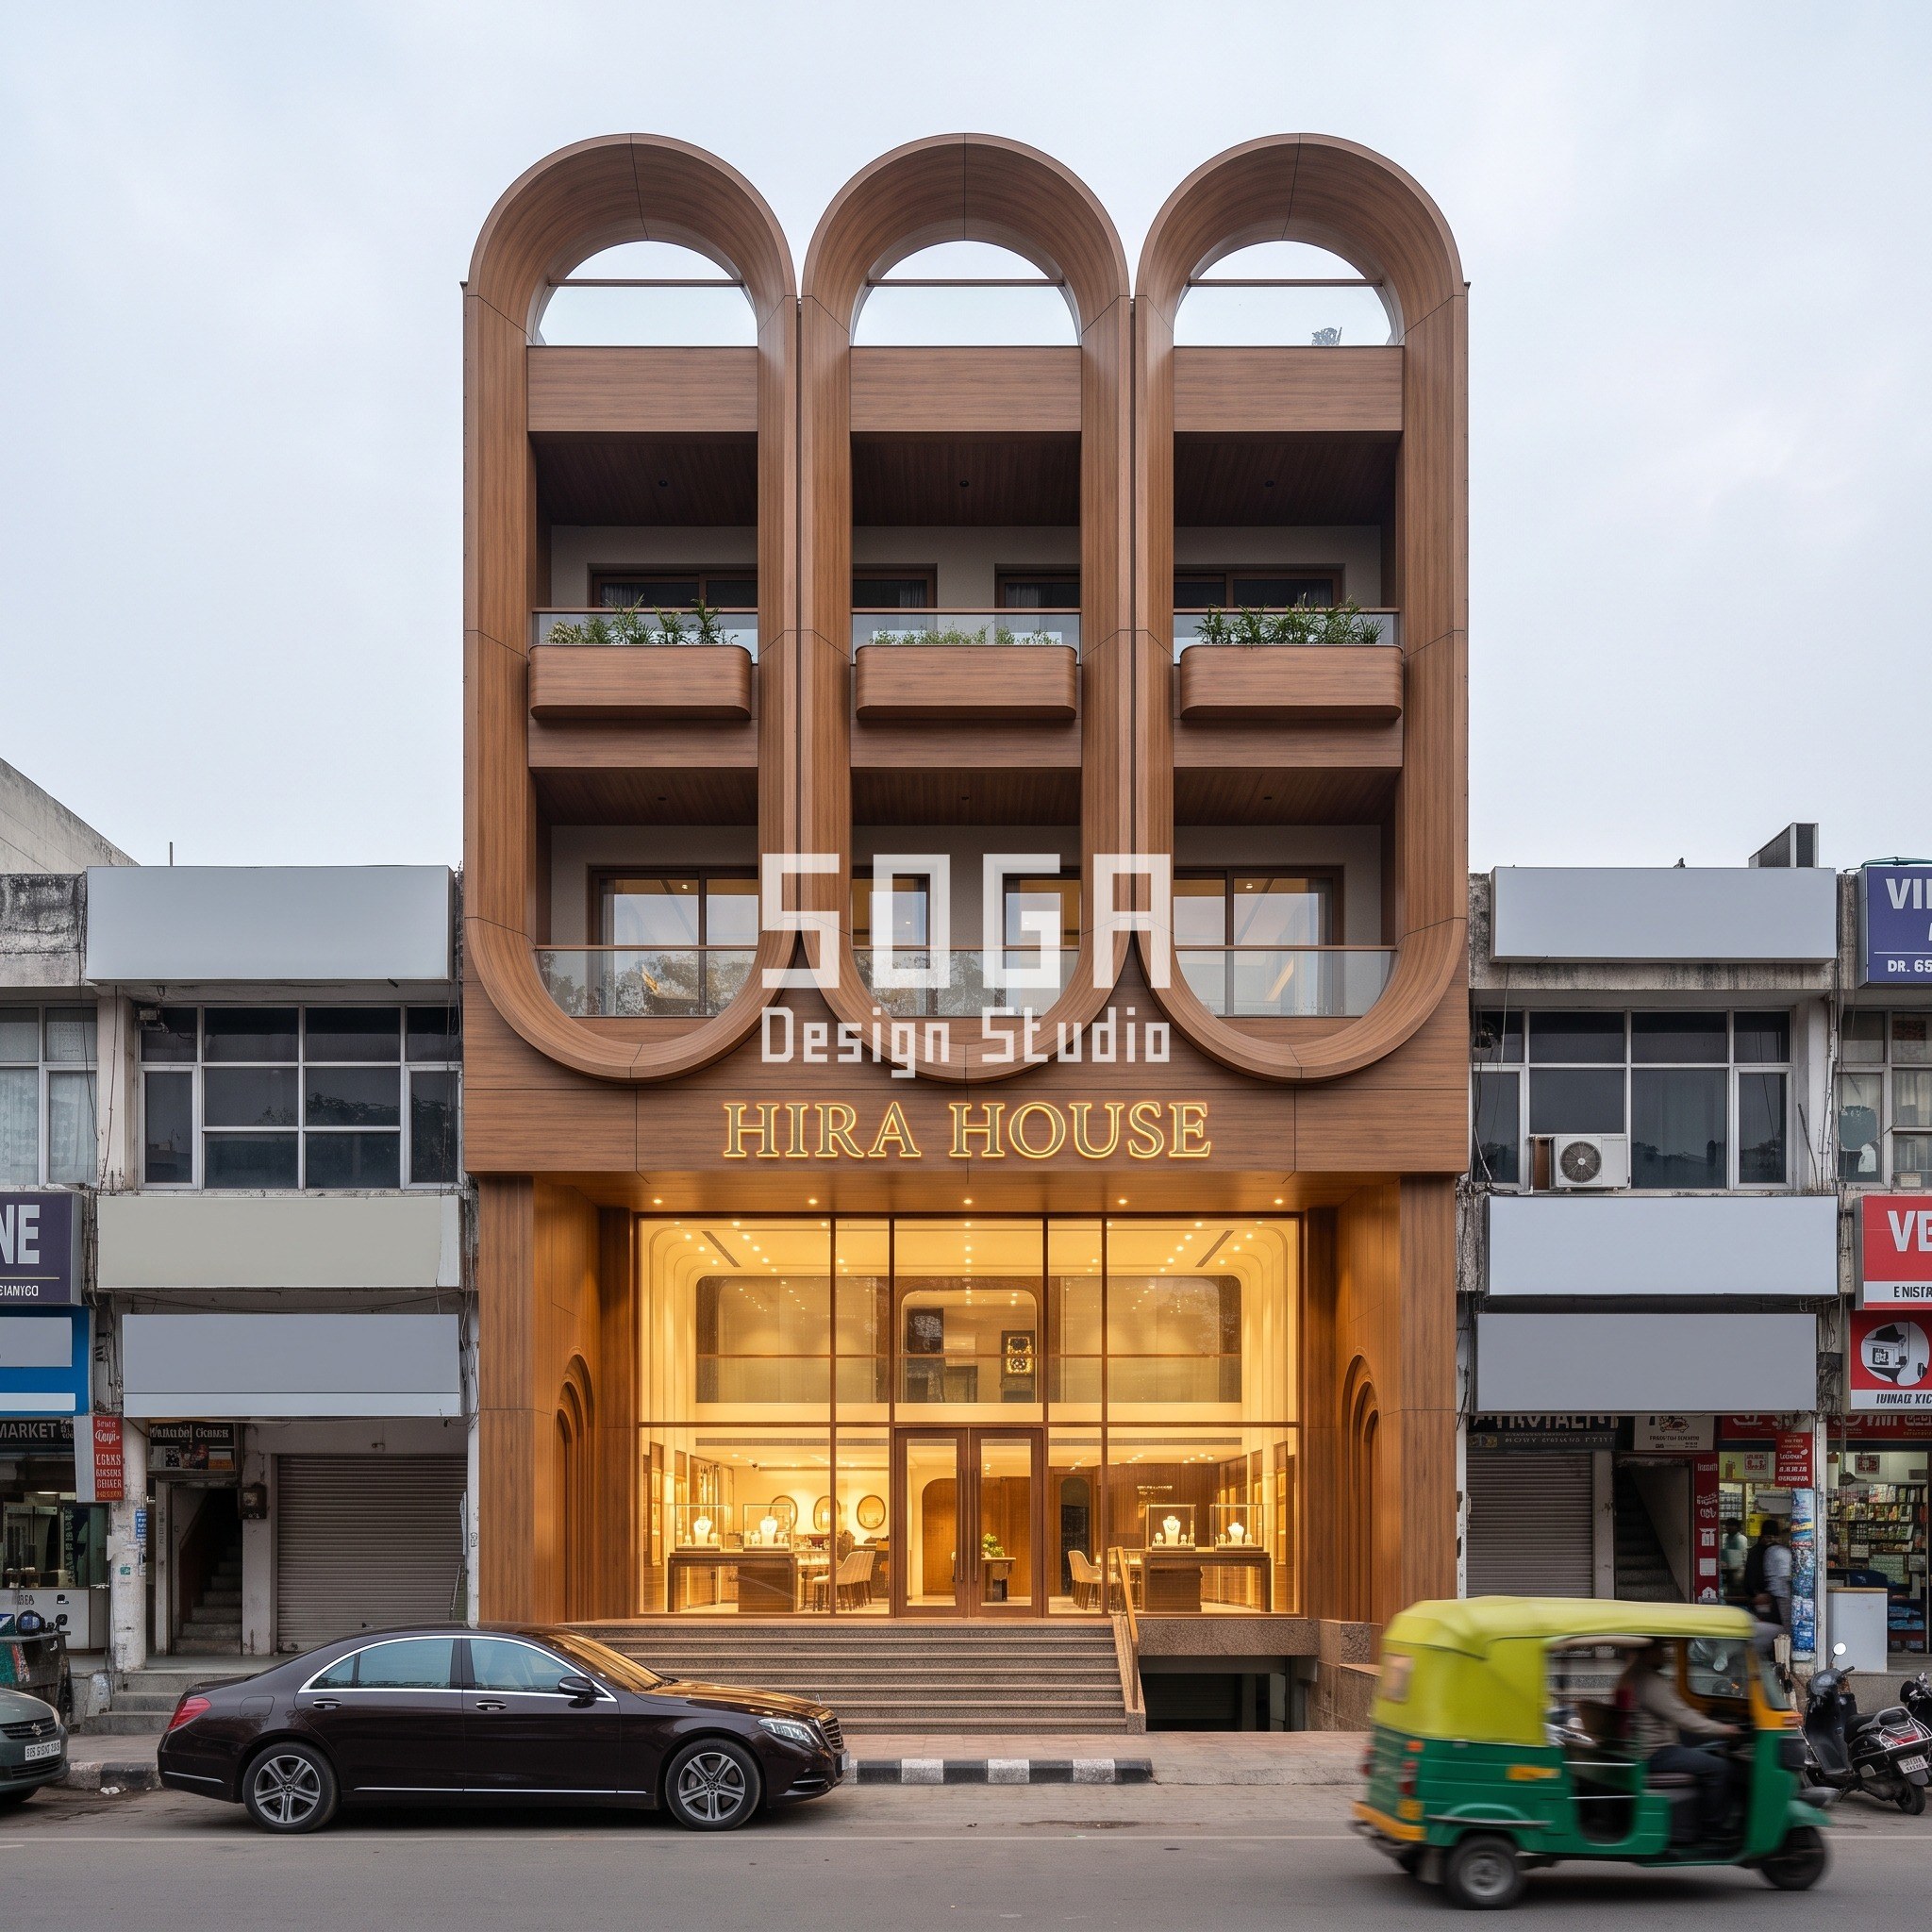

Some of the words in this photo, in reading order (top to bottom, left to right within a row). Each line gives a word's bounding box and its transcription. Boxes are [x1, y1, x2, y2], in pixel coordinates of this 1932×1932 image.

[1886, 878, 1932, 909] VI
[1888, 960, 1910, 973] DR.
[724, 1101, 922, 1158] HIRA
[949, 1101, 1212, 1159] HOUSE
[0, 1423, 57, 1439] MARKET
